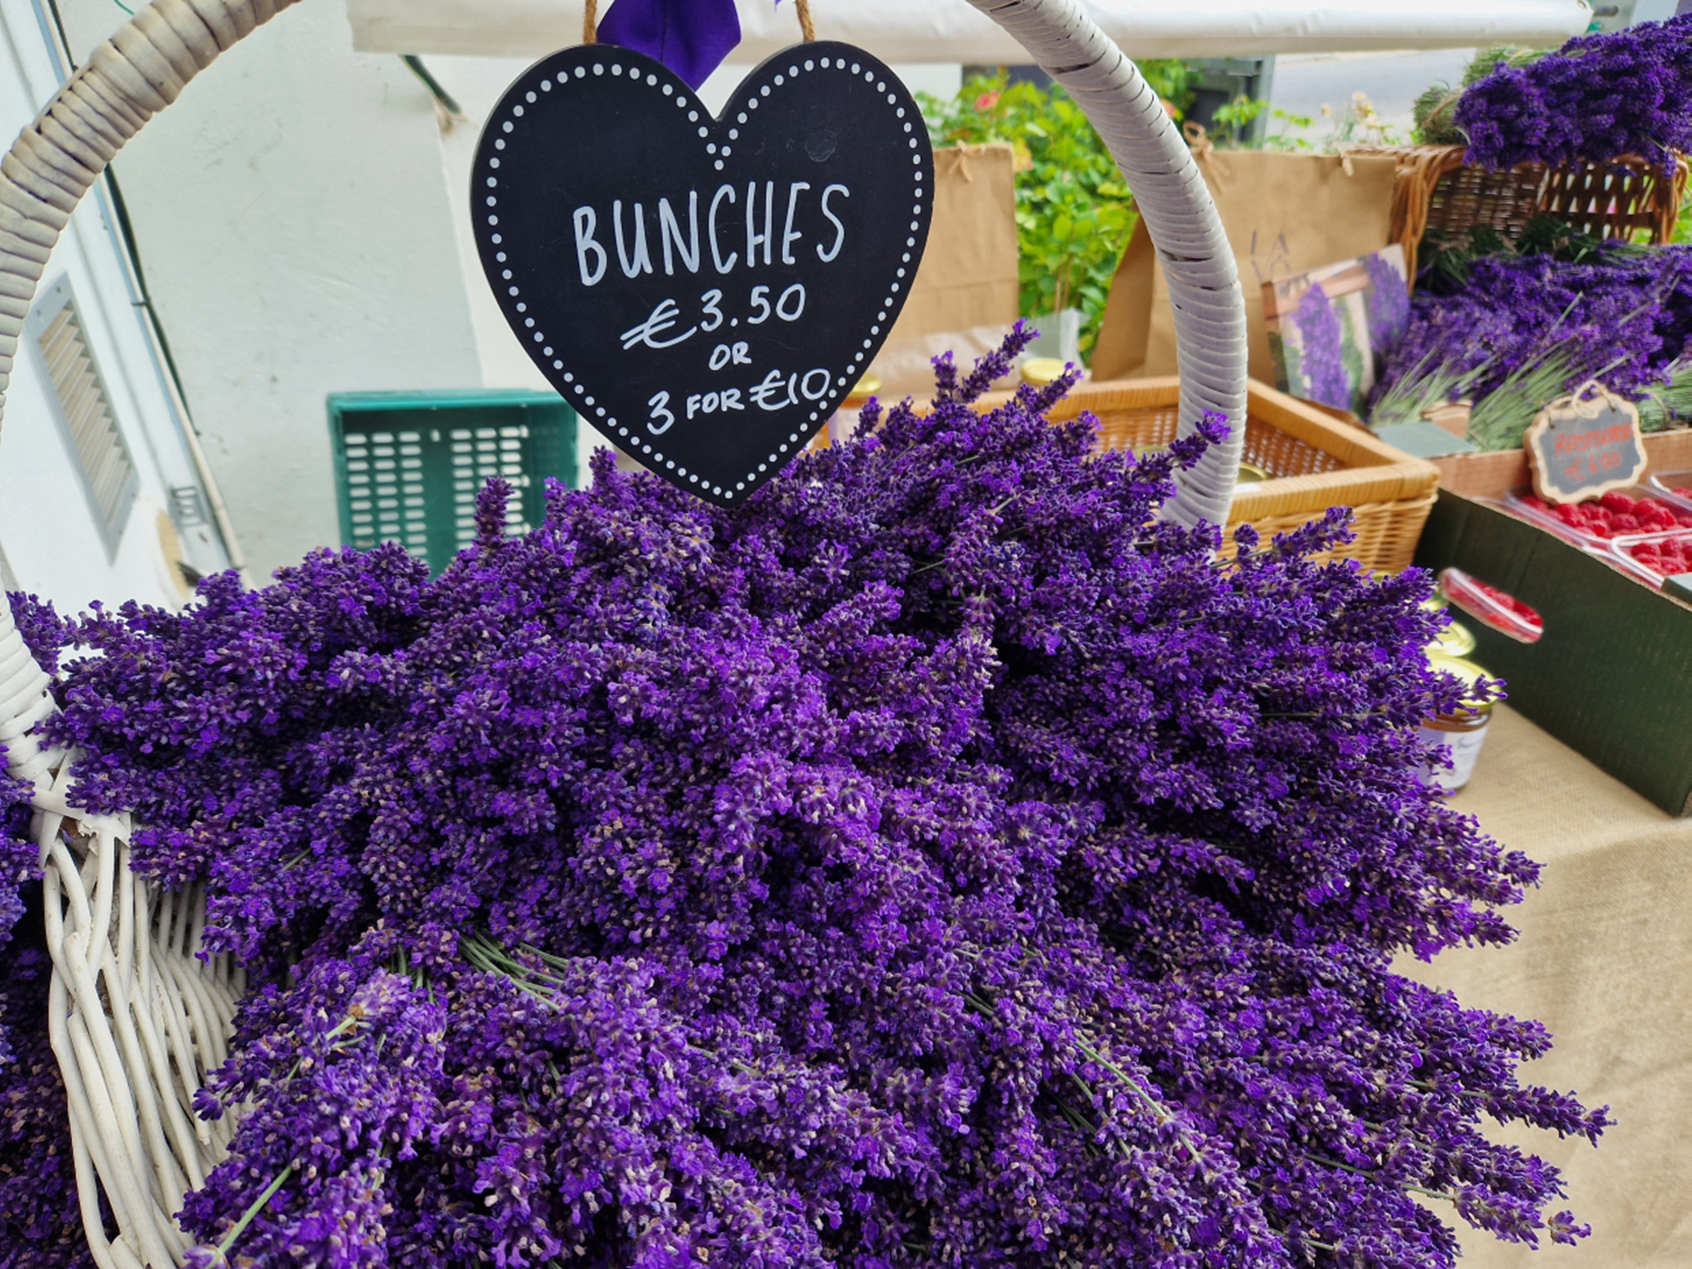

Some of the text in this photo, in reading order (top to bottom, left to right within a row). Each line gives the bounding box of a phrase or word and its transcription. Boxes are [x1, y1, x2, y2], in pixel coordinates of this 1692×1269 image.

[572, 181, 850, 286] BUNCHES
[620, 283, 806, 349] €3.50
[708, 341, 752, 371] OR
[647, 368, 831, 435] 3 FOR €10
